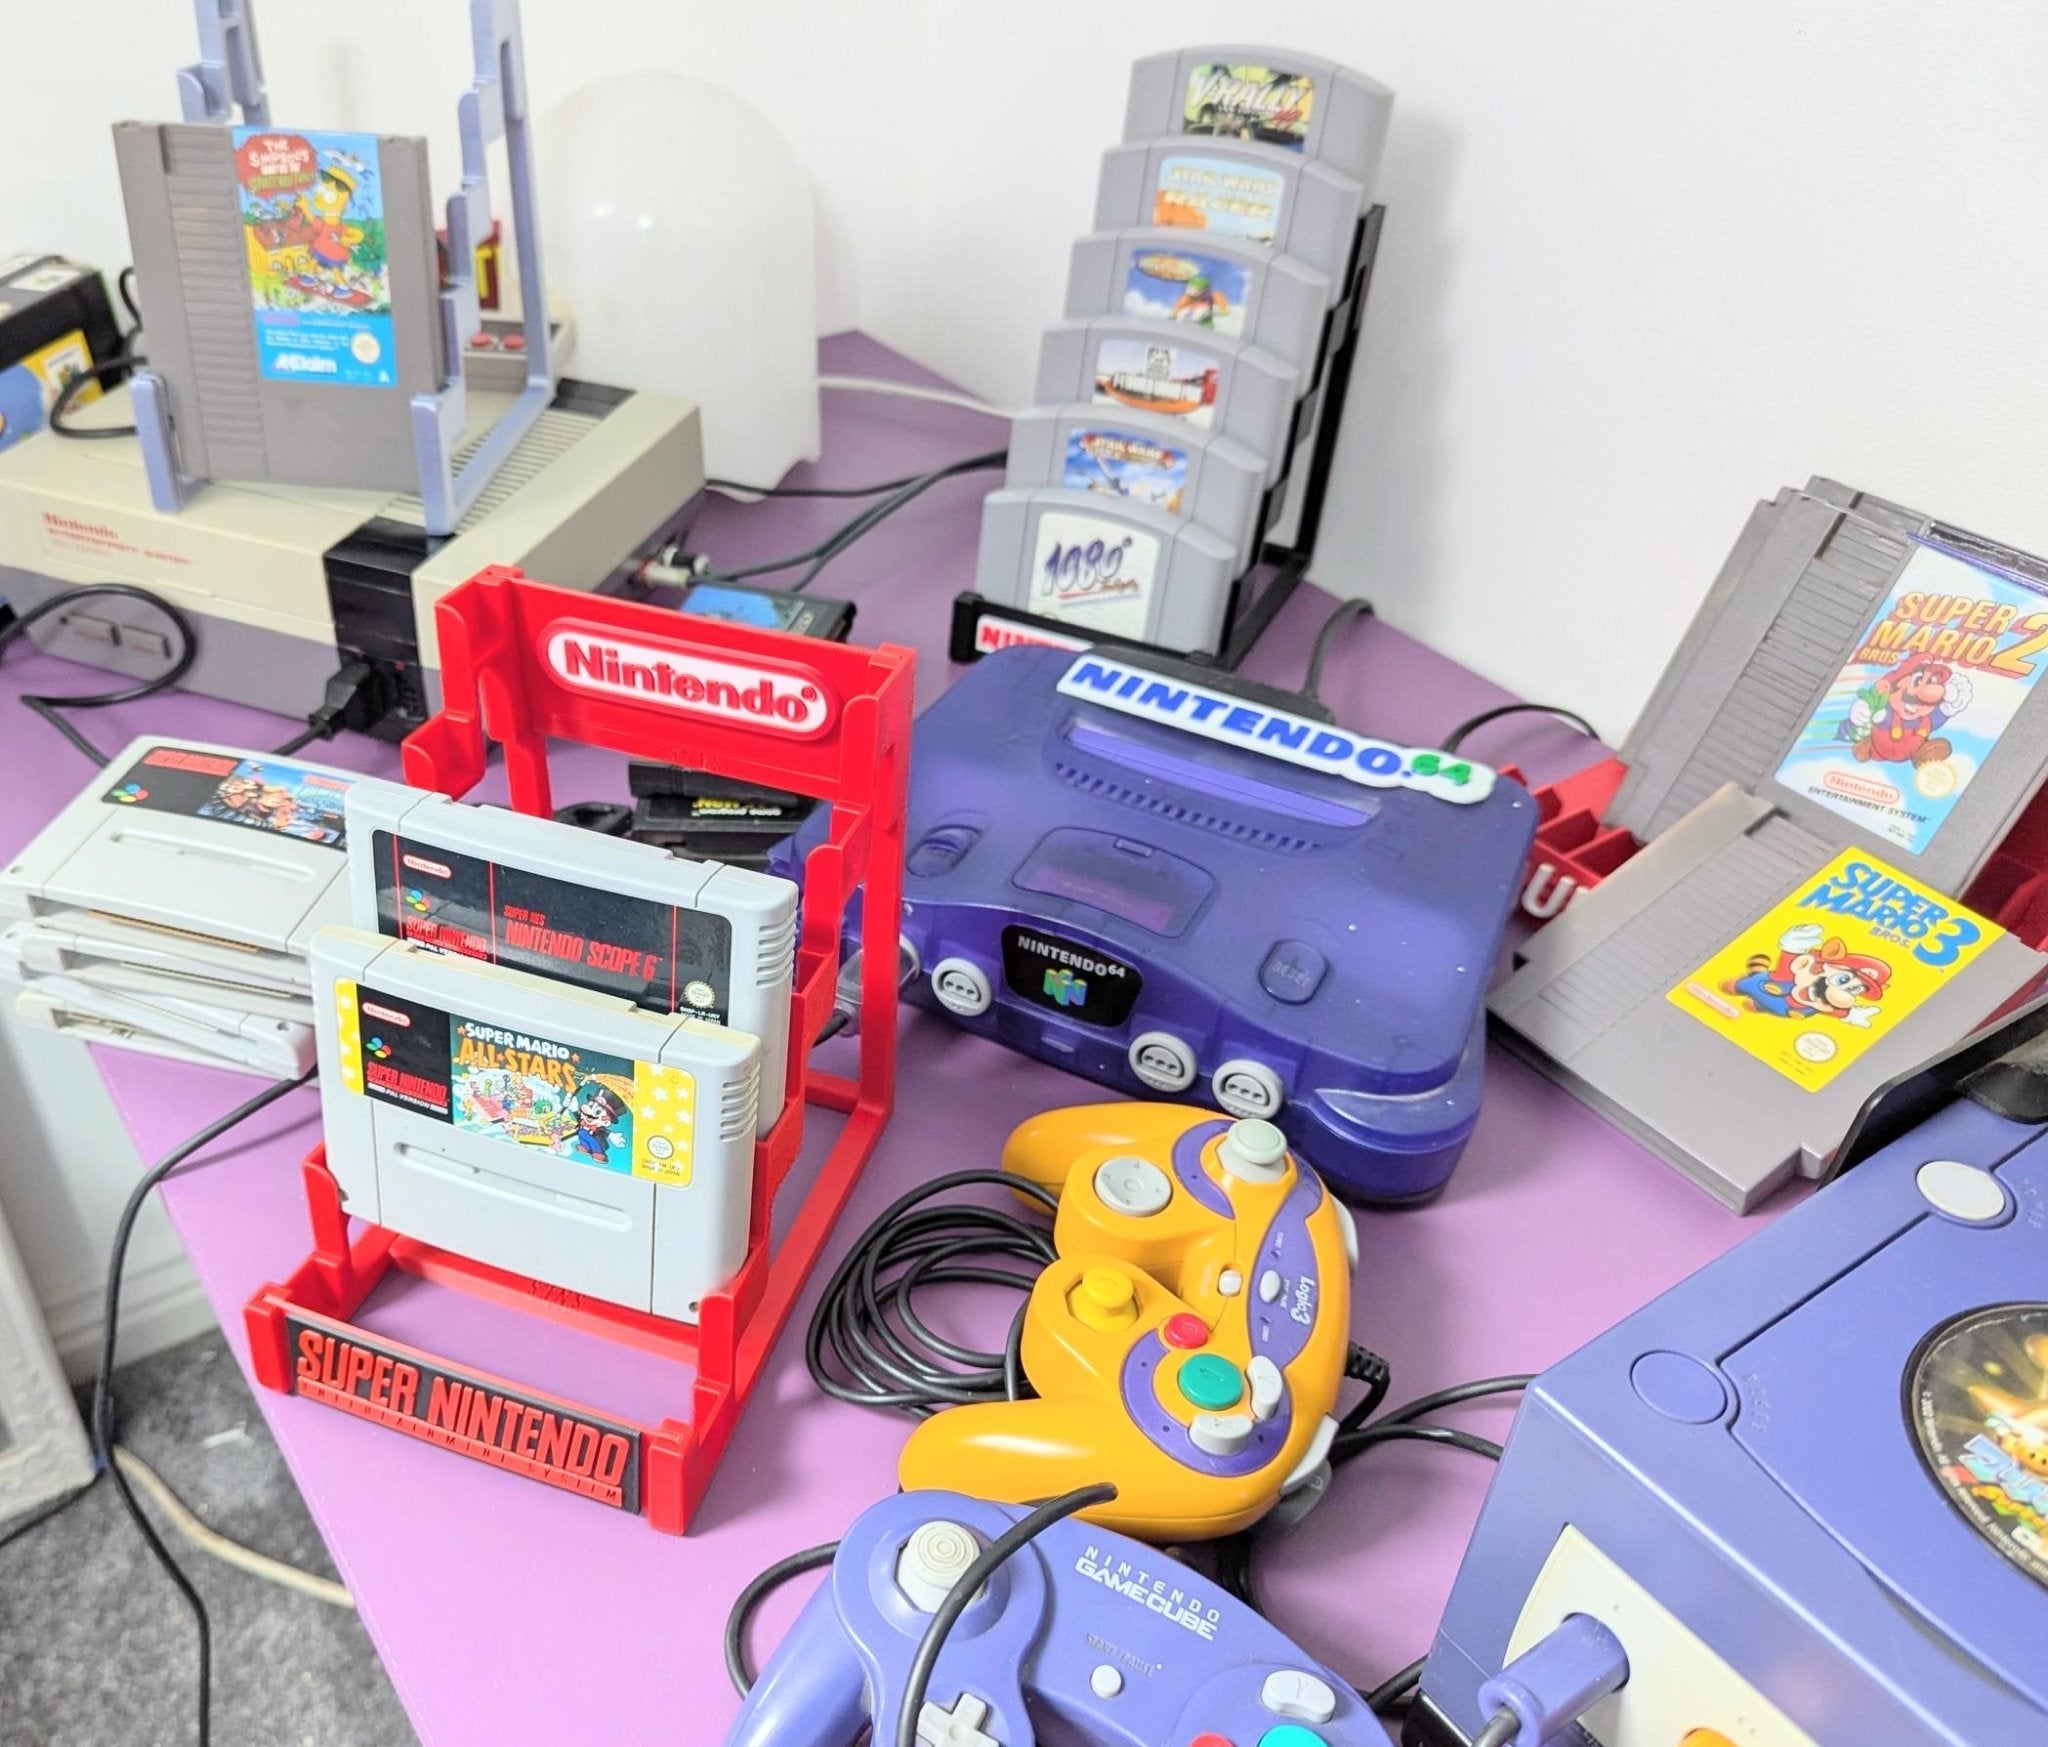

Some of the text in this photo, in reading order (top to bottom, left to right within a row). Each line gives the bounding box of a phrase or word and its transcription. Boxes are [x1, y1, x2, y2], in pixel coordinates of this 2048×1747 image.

[1893, 591, 2018, 637] SUPER
[1866, 619, 1997, 668] MARIO
[1807, 785, 1886, 813] ENTERTAINMENT
[1829, 775, 1894, 800] Nintendo
[503, 904, 530, 921] SUPER
[1829, 861, 1949, 926] SUPER
[405, 915, 438, 939] SUPER
[505, 920, 585, 964] NINTENDO
[586, 940, 642, 977] SCOPE
[1797, 883, 1981, 967] MARIO 3
[457, 1036, 579, 1094] ALL STARS
[465, 1022, 571, 1060] SUPER MARIO
[366, 1060, 399, 1085] SUPER
[400, 1072, 447, 1100] NINTENDO
[297, 1328, 631, 1488] SUPER NINTENDO
[1075, 1556, 1218, 1642] GAMECUBE
[1084, 1545, 1220, 1623] NINTENDO
